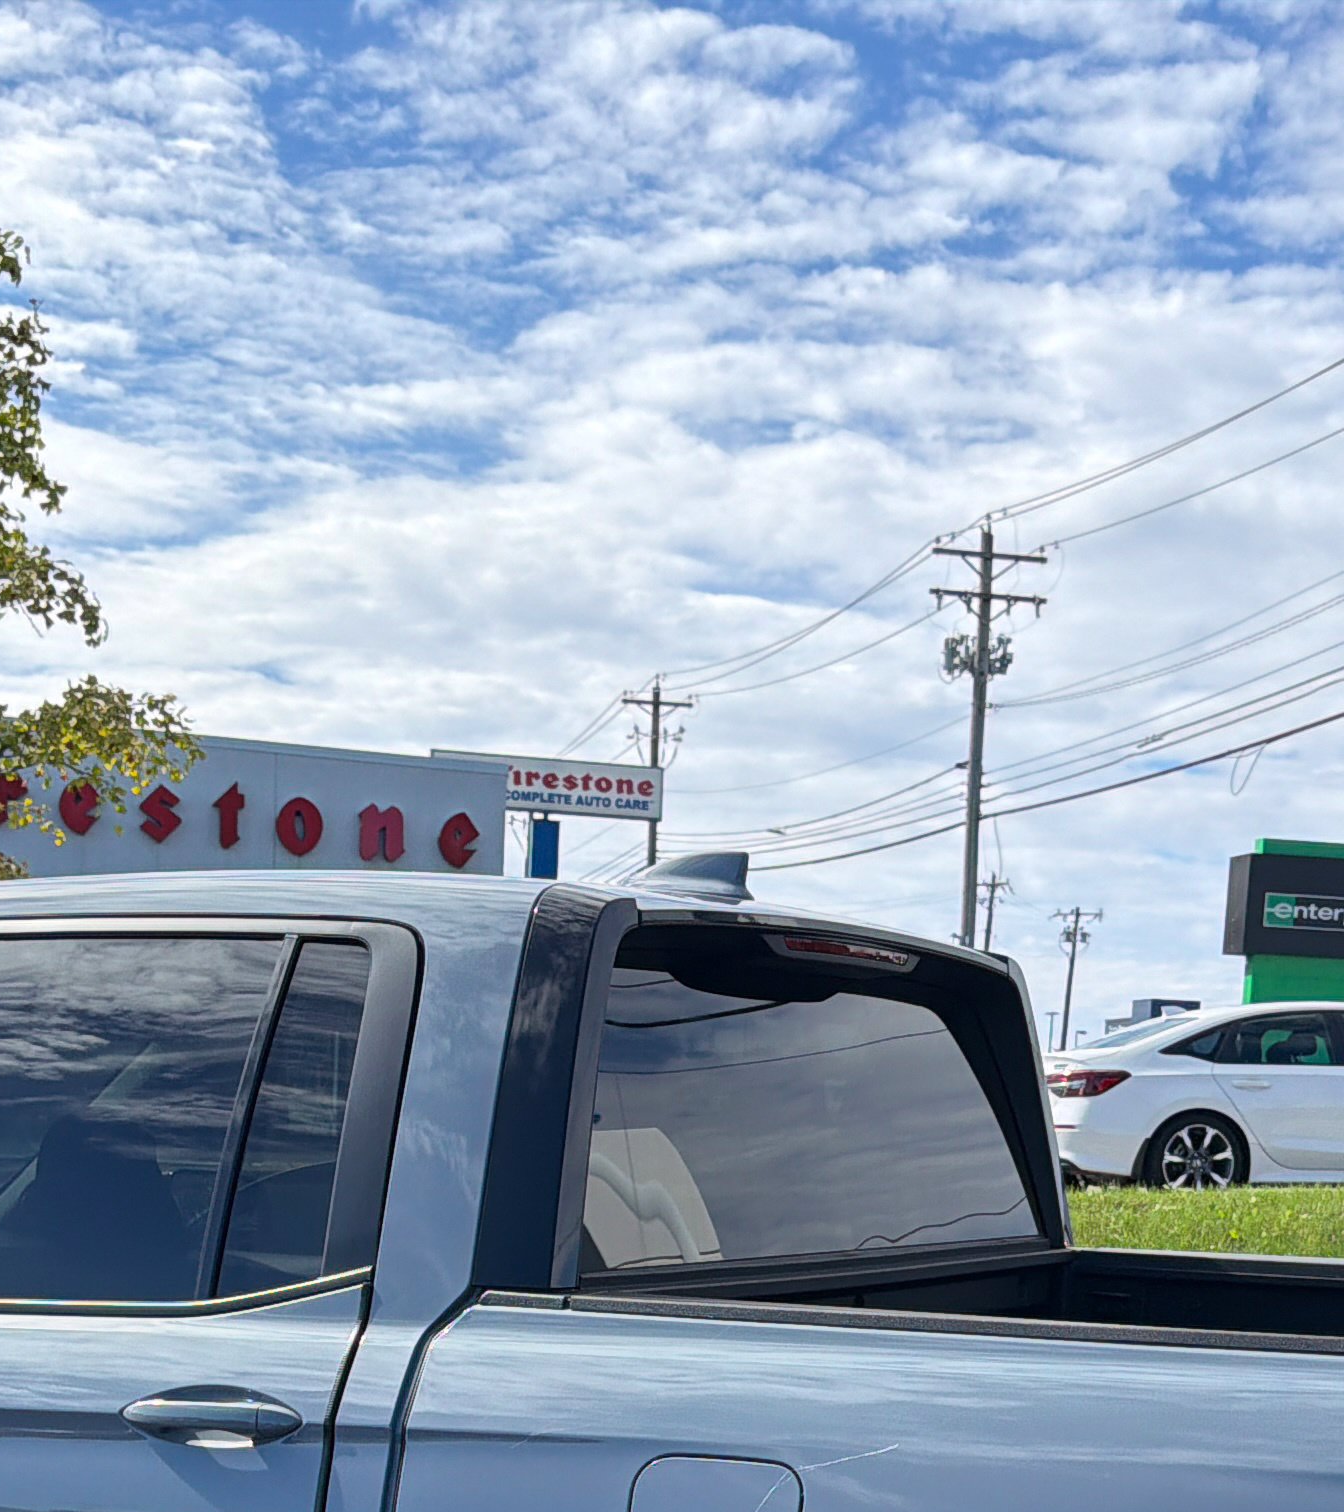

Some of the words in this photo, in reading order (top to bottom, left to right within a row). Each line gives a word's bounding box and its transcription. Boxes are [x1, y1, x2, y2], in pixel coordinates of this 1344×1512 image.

[508, 765, 654, 797] irestone
[575, 795, 612, 808] AUTO
[614, 797, 650, 812] CARE
